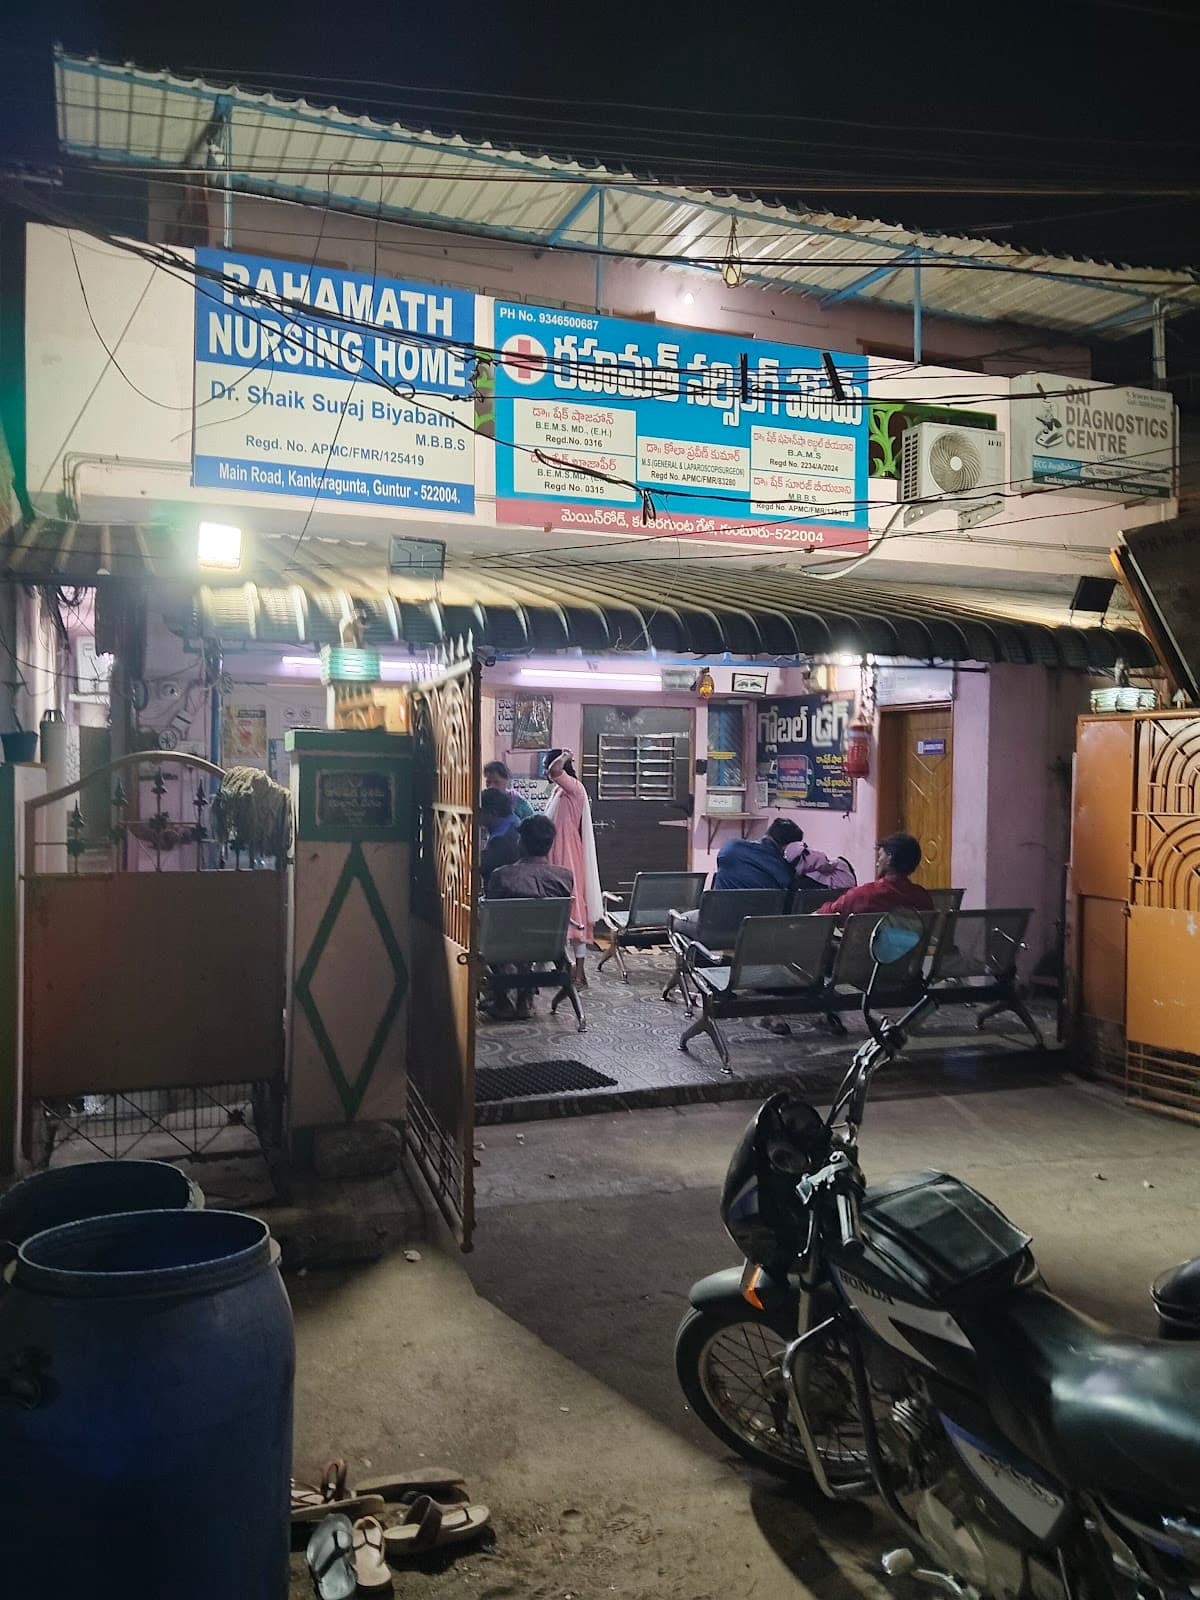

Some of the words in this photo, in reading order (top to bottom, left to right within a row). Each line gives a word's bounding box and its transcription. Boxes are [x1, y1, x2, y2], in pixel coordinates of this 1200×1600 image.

[221, 262, 454, 337] RAHAMATH
[500, 308, 515, 319] PH
[519, 310, 536, 322] No.
[539, 313, 599, 330] 9346500687
[208, 311, 363, 374] NURSING
[374, 338, 466, 388] HOME
[211, 380, 240, 402] Dr.
[247, 385, 306, 411] Shaik
[312, 392, 365, 422] Suraj
[371, 399, 456, 429] Biyabani
[1066, 406, 1168, 439] DIAGNOSTICS
[246, 435, 282, 452] Regd.
[286, 440, 308, 454] No.
[311, 442, 425, 466] APMC/FMR/125419
[415, 433, 466, 452] M.B.B.S
[584, 439, 603, 448] 0316
[1065, 428, 1127, 454] CENTRE
[769, 458, 787, 468] Regd
[788, 460, 800, 468] No.
[787, 449, 822, 460] B.A.M.S
[218, 462, 248, 482] Main
[250, 466, 285, 488] Road,
[288, 472, 370, 497] Kankaragunta,
[373, 479, 411, 499] Guntur
[421, 486, 461, 505] 522004.
[544, 482, 566, 492] Regd
[568, 484, 583, 492] No.
[585, 485, 604, 494] 0315
[651, 471, 668, 480] Regd
[669, 473, 680, 481] No.
